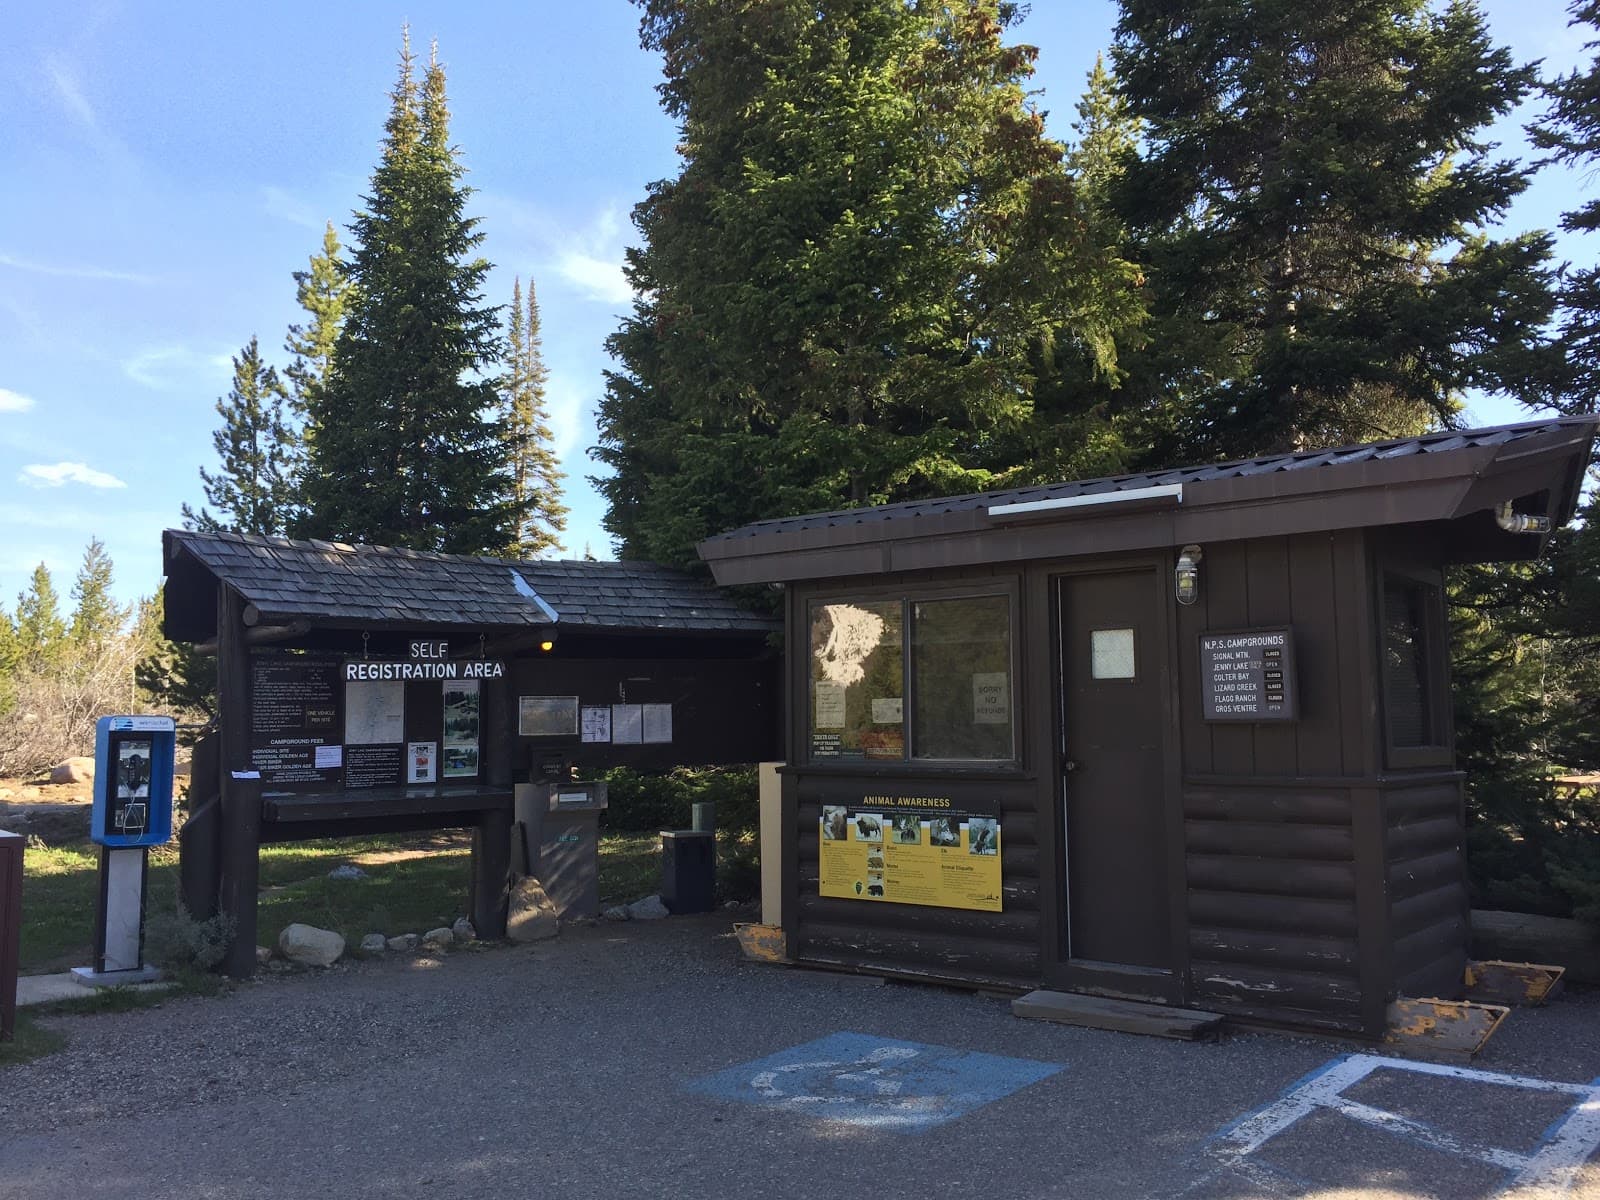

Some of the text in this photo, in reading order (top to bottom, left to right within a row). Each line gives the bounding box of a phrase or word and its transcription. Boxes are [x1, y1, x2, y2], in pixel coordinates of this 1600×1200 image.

[1204, 635, 1284, 650] N.P.S. CAMPGROUNDS
[411, 642, 449, 658] SELF
[1213, 652, 1234, 661] SIGNAL
[1235, 651, 1251, 659] MTN.
[347, 662, 503, 680] REGISTRATION AREA
[1213, 662, 1233, 671] JENNY
[1233, 661, 1249, 670] LAKE
[1214, 673, 1237, 682] COLTER
[1237, 672, 1250, 681] BAY
[1214, 684, 1236, 692] LIZARD
[1236, 683, 1258, 691] CREEK
[985, 696, 997, 704] NO
[1214, 695, 1234, 703] FLAGG
[1234, 694, 1257, 702] RANCH
[1215, 705, 1232, 713] GROS
[1232, 704, 1257, 713] VENTRE
[270, 738, 310, 746] CAMPGROUND
[863, 795, 951, 808] ANIMAL AWARENESS
